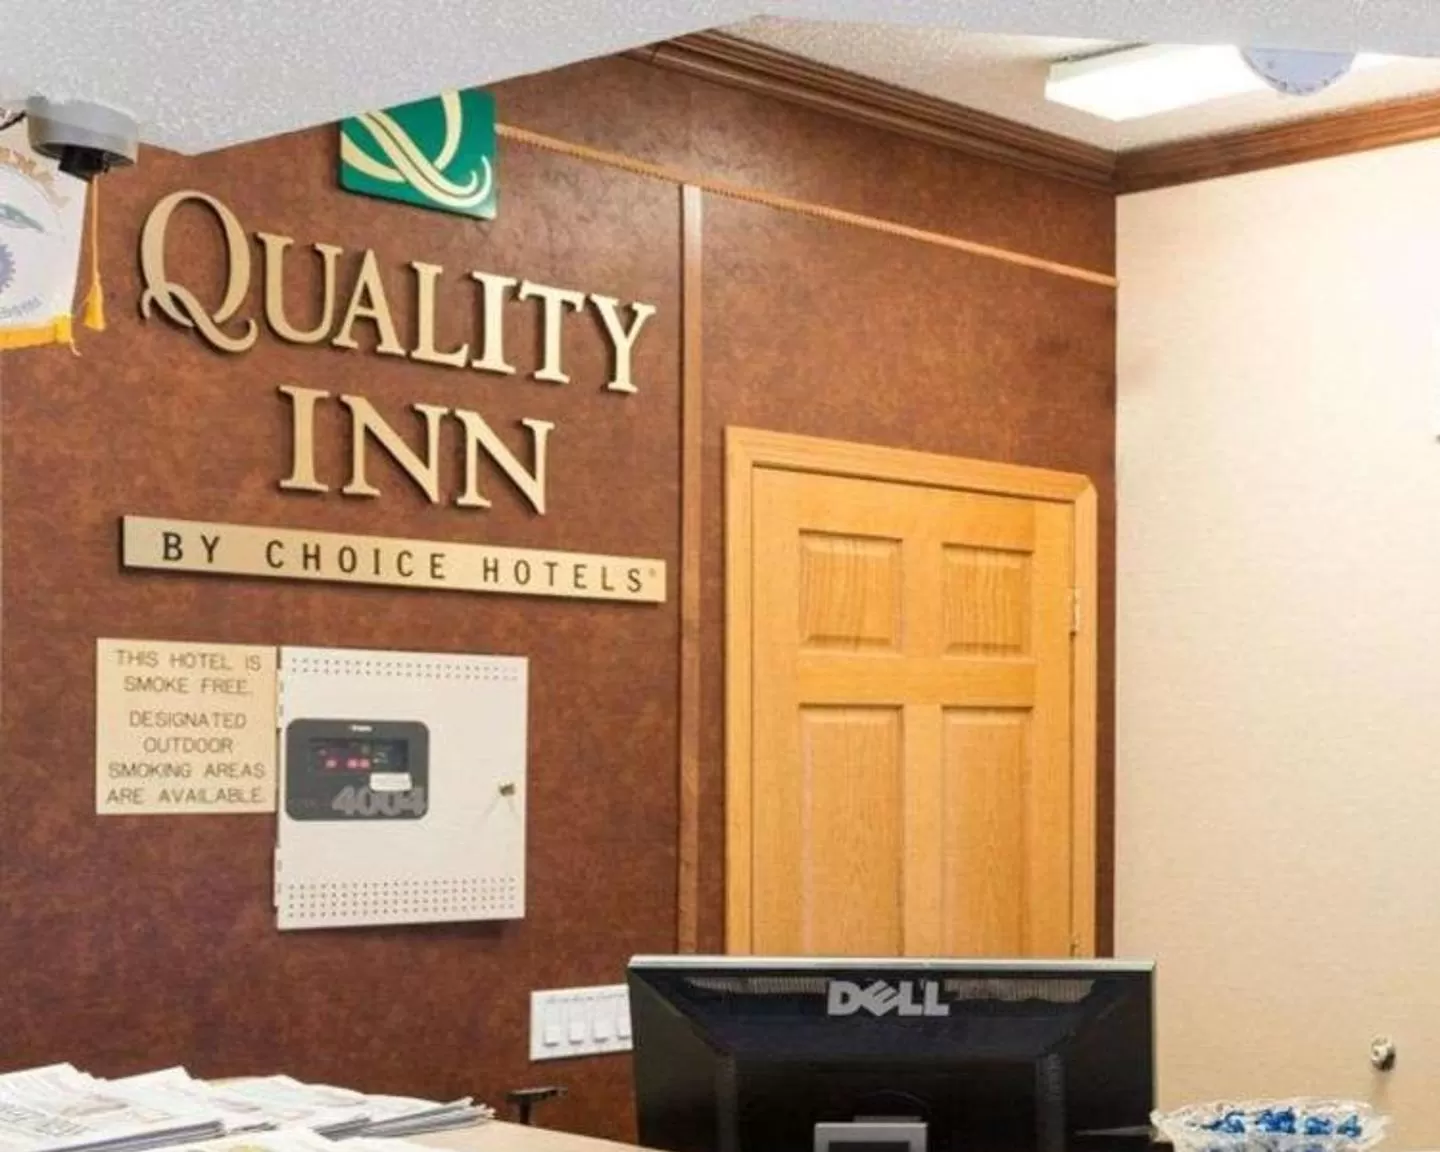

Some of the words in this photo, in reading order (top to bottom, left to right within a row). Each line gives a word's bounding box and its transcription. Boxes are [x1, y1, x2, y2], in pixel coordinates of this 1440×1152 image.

[140, 189, 657, 393] QUALITY
[279, 384, 555, 515] INN
[162, 531, 220, 564] BY
[265, 539, 446, 580] CHOICE
[484, 555, 643, 594] HOTELS
[115, 649, 159, 668] THIS
[171, 652, 232, 670] HOTEL
[244, 655, 262, 671] IS
[124, 675, 190, 693] SMOKE
[129, 709, 247, 729] DESIGNATED
[143, 736, 234, 754] OUTDOOR
[108, 761, 191, 779] SMOKING
[203, 761, 266, 779] AREAS
[106, 787, 145, 805] ARE
[827, 979, 949, 1016] DELL
